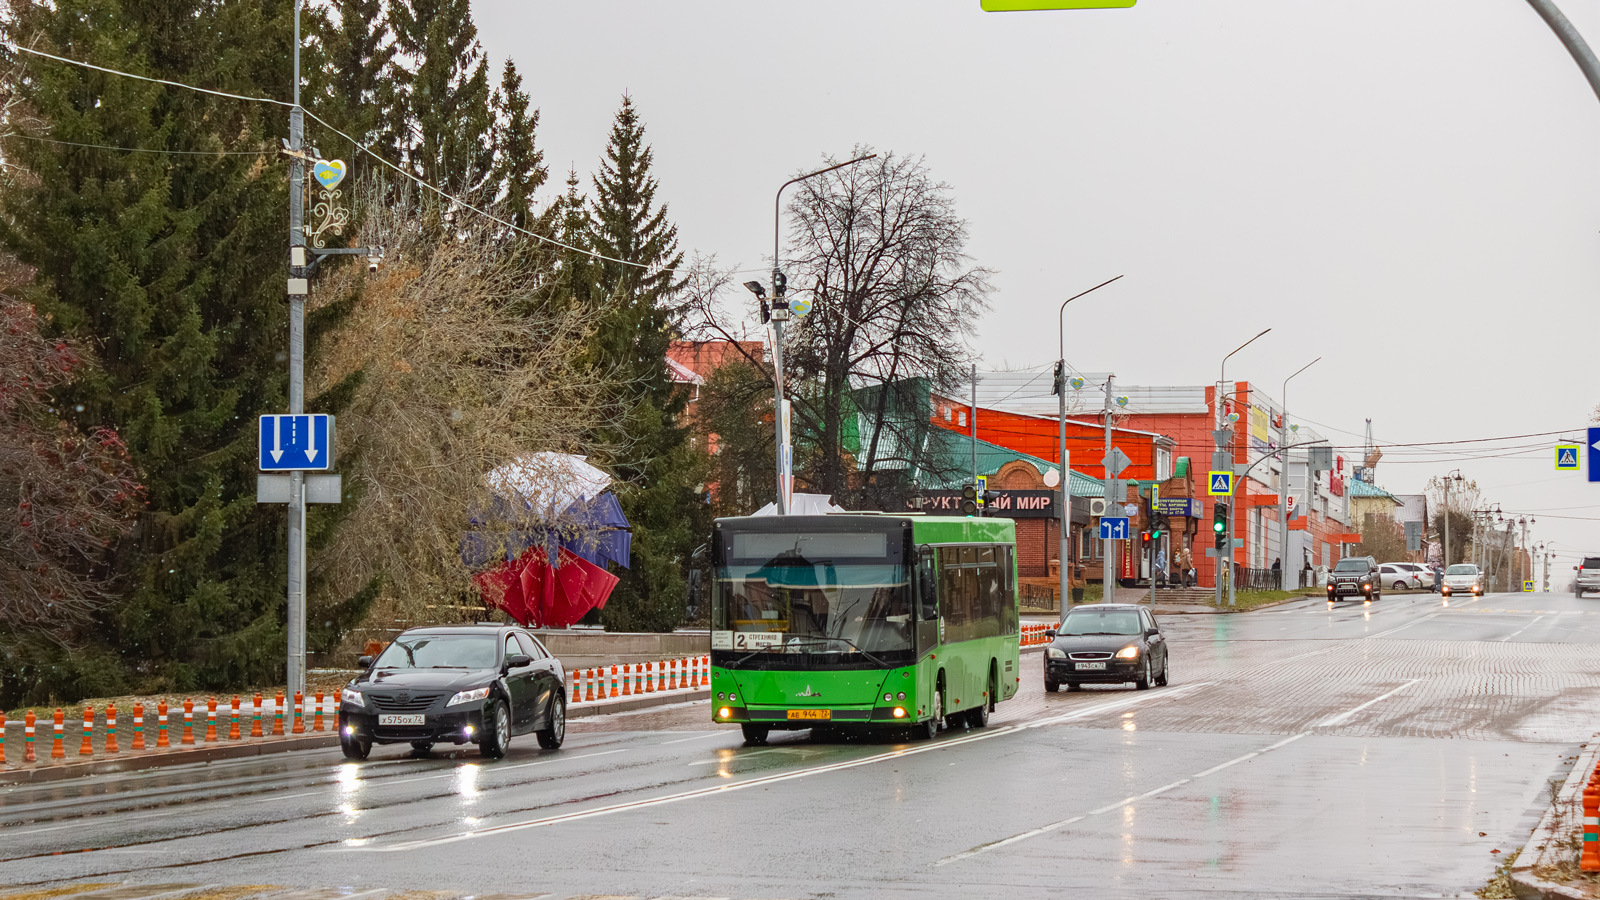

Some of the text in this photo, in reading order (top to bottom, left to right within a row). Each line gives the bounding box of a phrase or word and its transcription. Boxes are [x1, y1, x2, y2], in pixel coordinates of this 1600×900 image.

[906, 493, 1051, 510] РУКТЫЙ МИР
[1287, 496, 1293, 506] 9
[737, 634, 745, 647] 2
